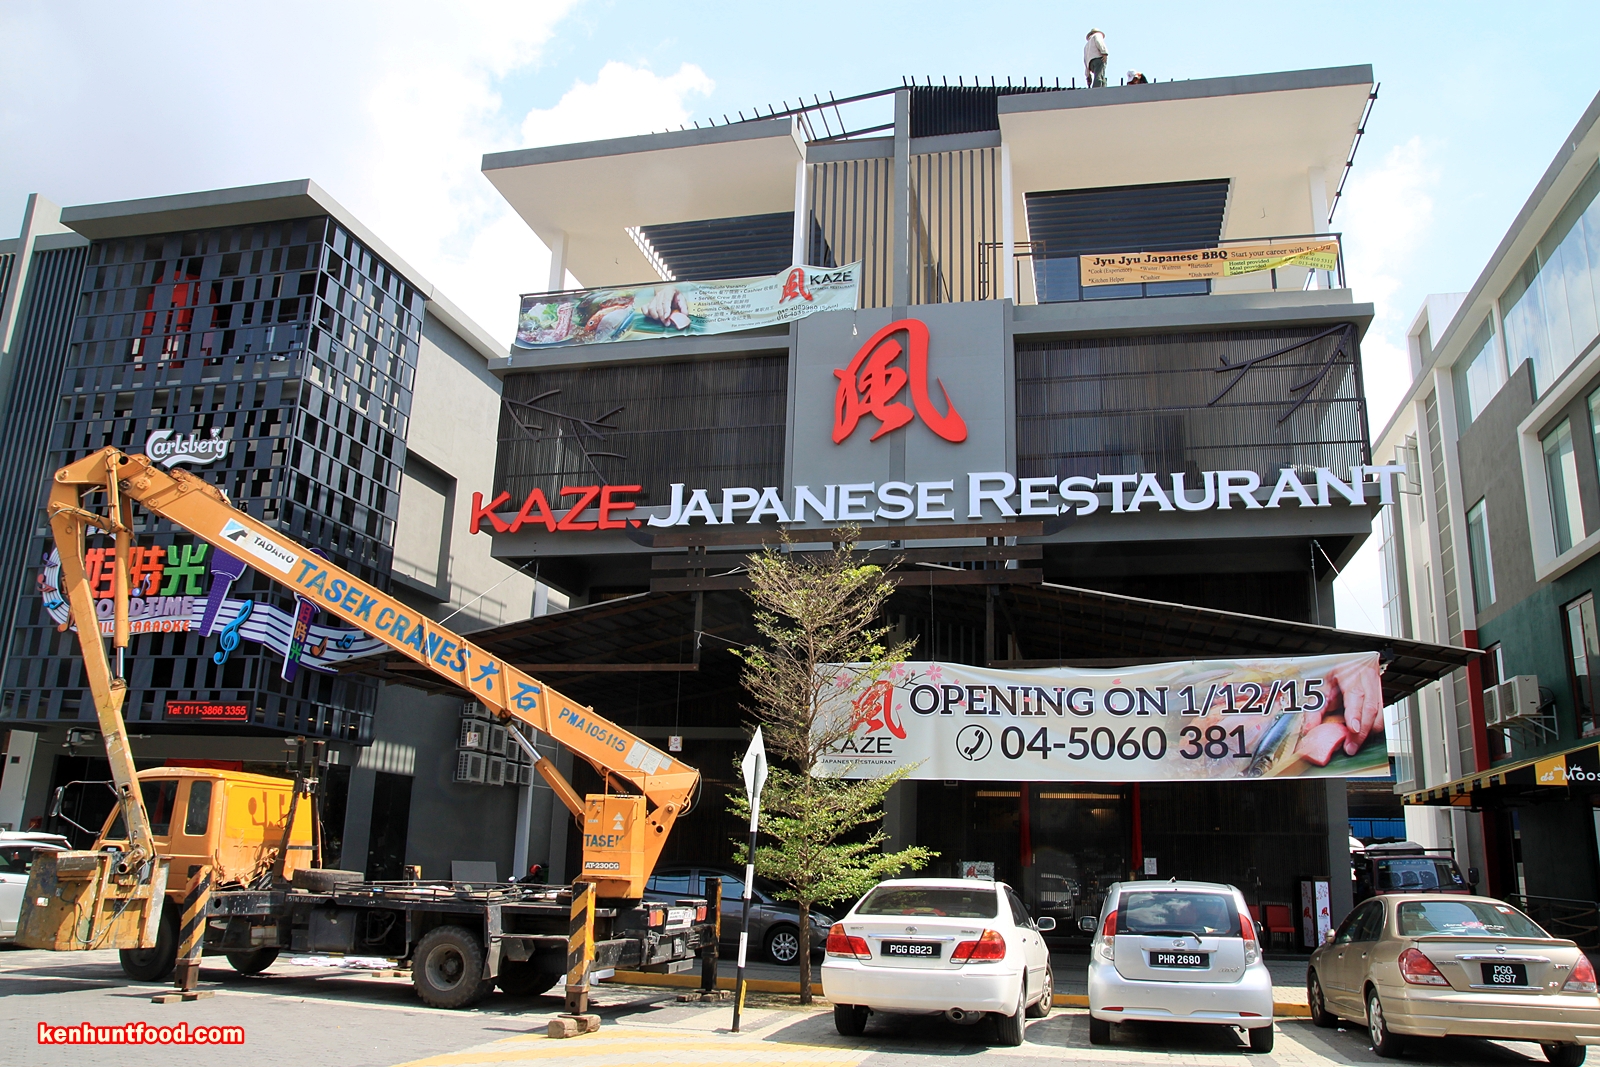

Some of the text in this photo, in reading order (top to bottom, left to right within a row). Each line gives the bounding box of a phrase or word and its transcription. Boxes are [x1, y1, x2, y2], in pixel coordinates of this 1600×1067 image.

[1093, 250, 1228, 266] Jyu Jyu Japanese BBQ
[1249, 250, 1265, 259] your
[1289, 246, 1304, 254] with
[810, 271, 853, 285] KAZE
[145, 427, 229, 467] Carlsberg
[469, 463, 1407, 534] KAZE JAPANESE RESTAURANT
[253, 536, 295, 564] TADANO
[145, 595, 195, 616] TIME
[294, 558, 473, 673] TASEK CRANES
[909, 679, 1326, 717] OPENING ON 1/12/15
[168, 705, 247, 715] Tel: 011-3866 3355
[557, 706, 628, 753] PMA105115
[1000, 724, 1253, 761] 04-5060 381
[890, 944, 933, 955] PGG 6823
[1158, 954, 1201, 965] PHR 2680
[1492, 974, 1517, 984] 6697
